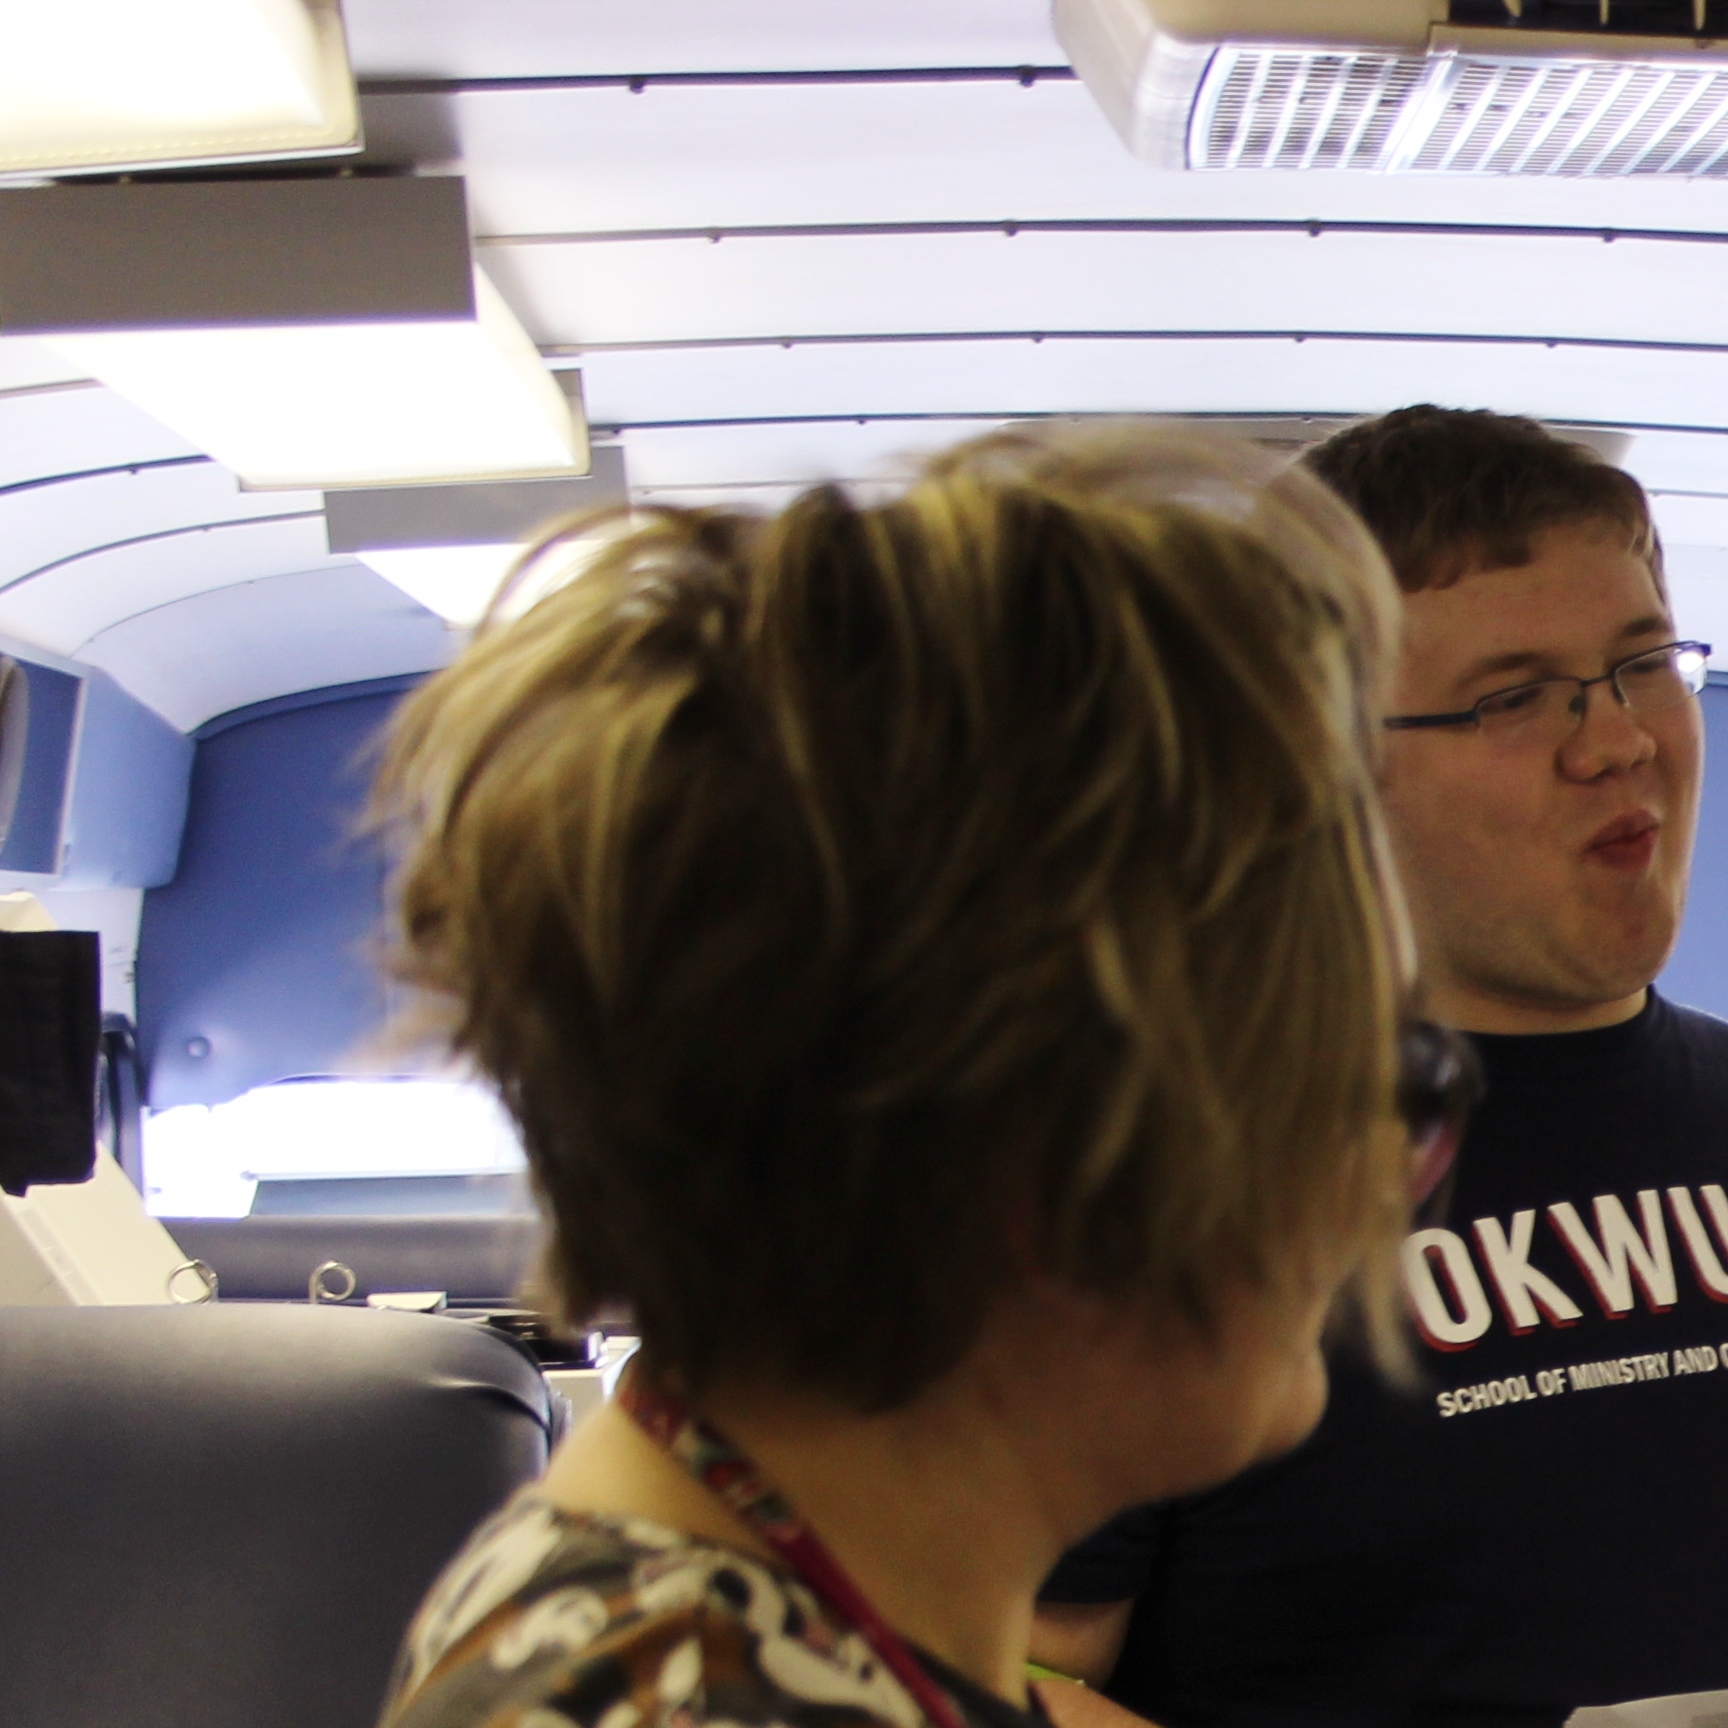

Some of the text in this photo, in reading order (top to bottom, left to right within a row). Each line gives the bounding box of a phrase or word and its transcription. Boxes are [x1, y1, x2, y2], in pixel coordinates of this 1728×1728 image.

[1436, 1374, 1537, 1418] SCHOOL
[1536, 1368, 1568, 1397] OF
[1567, 1351, 1670, 1391] MINISTRY
[1673, 1345, 1719, 1376] AND
